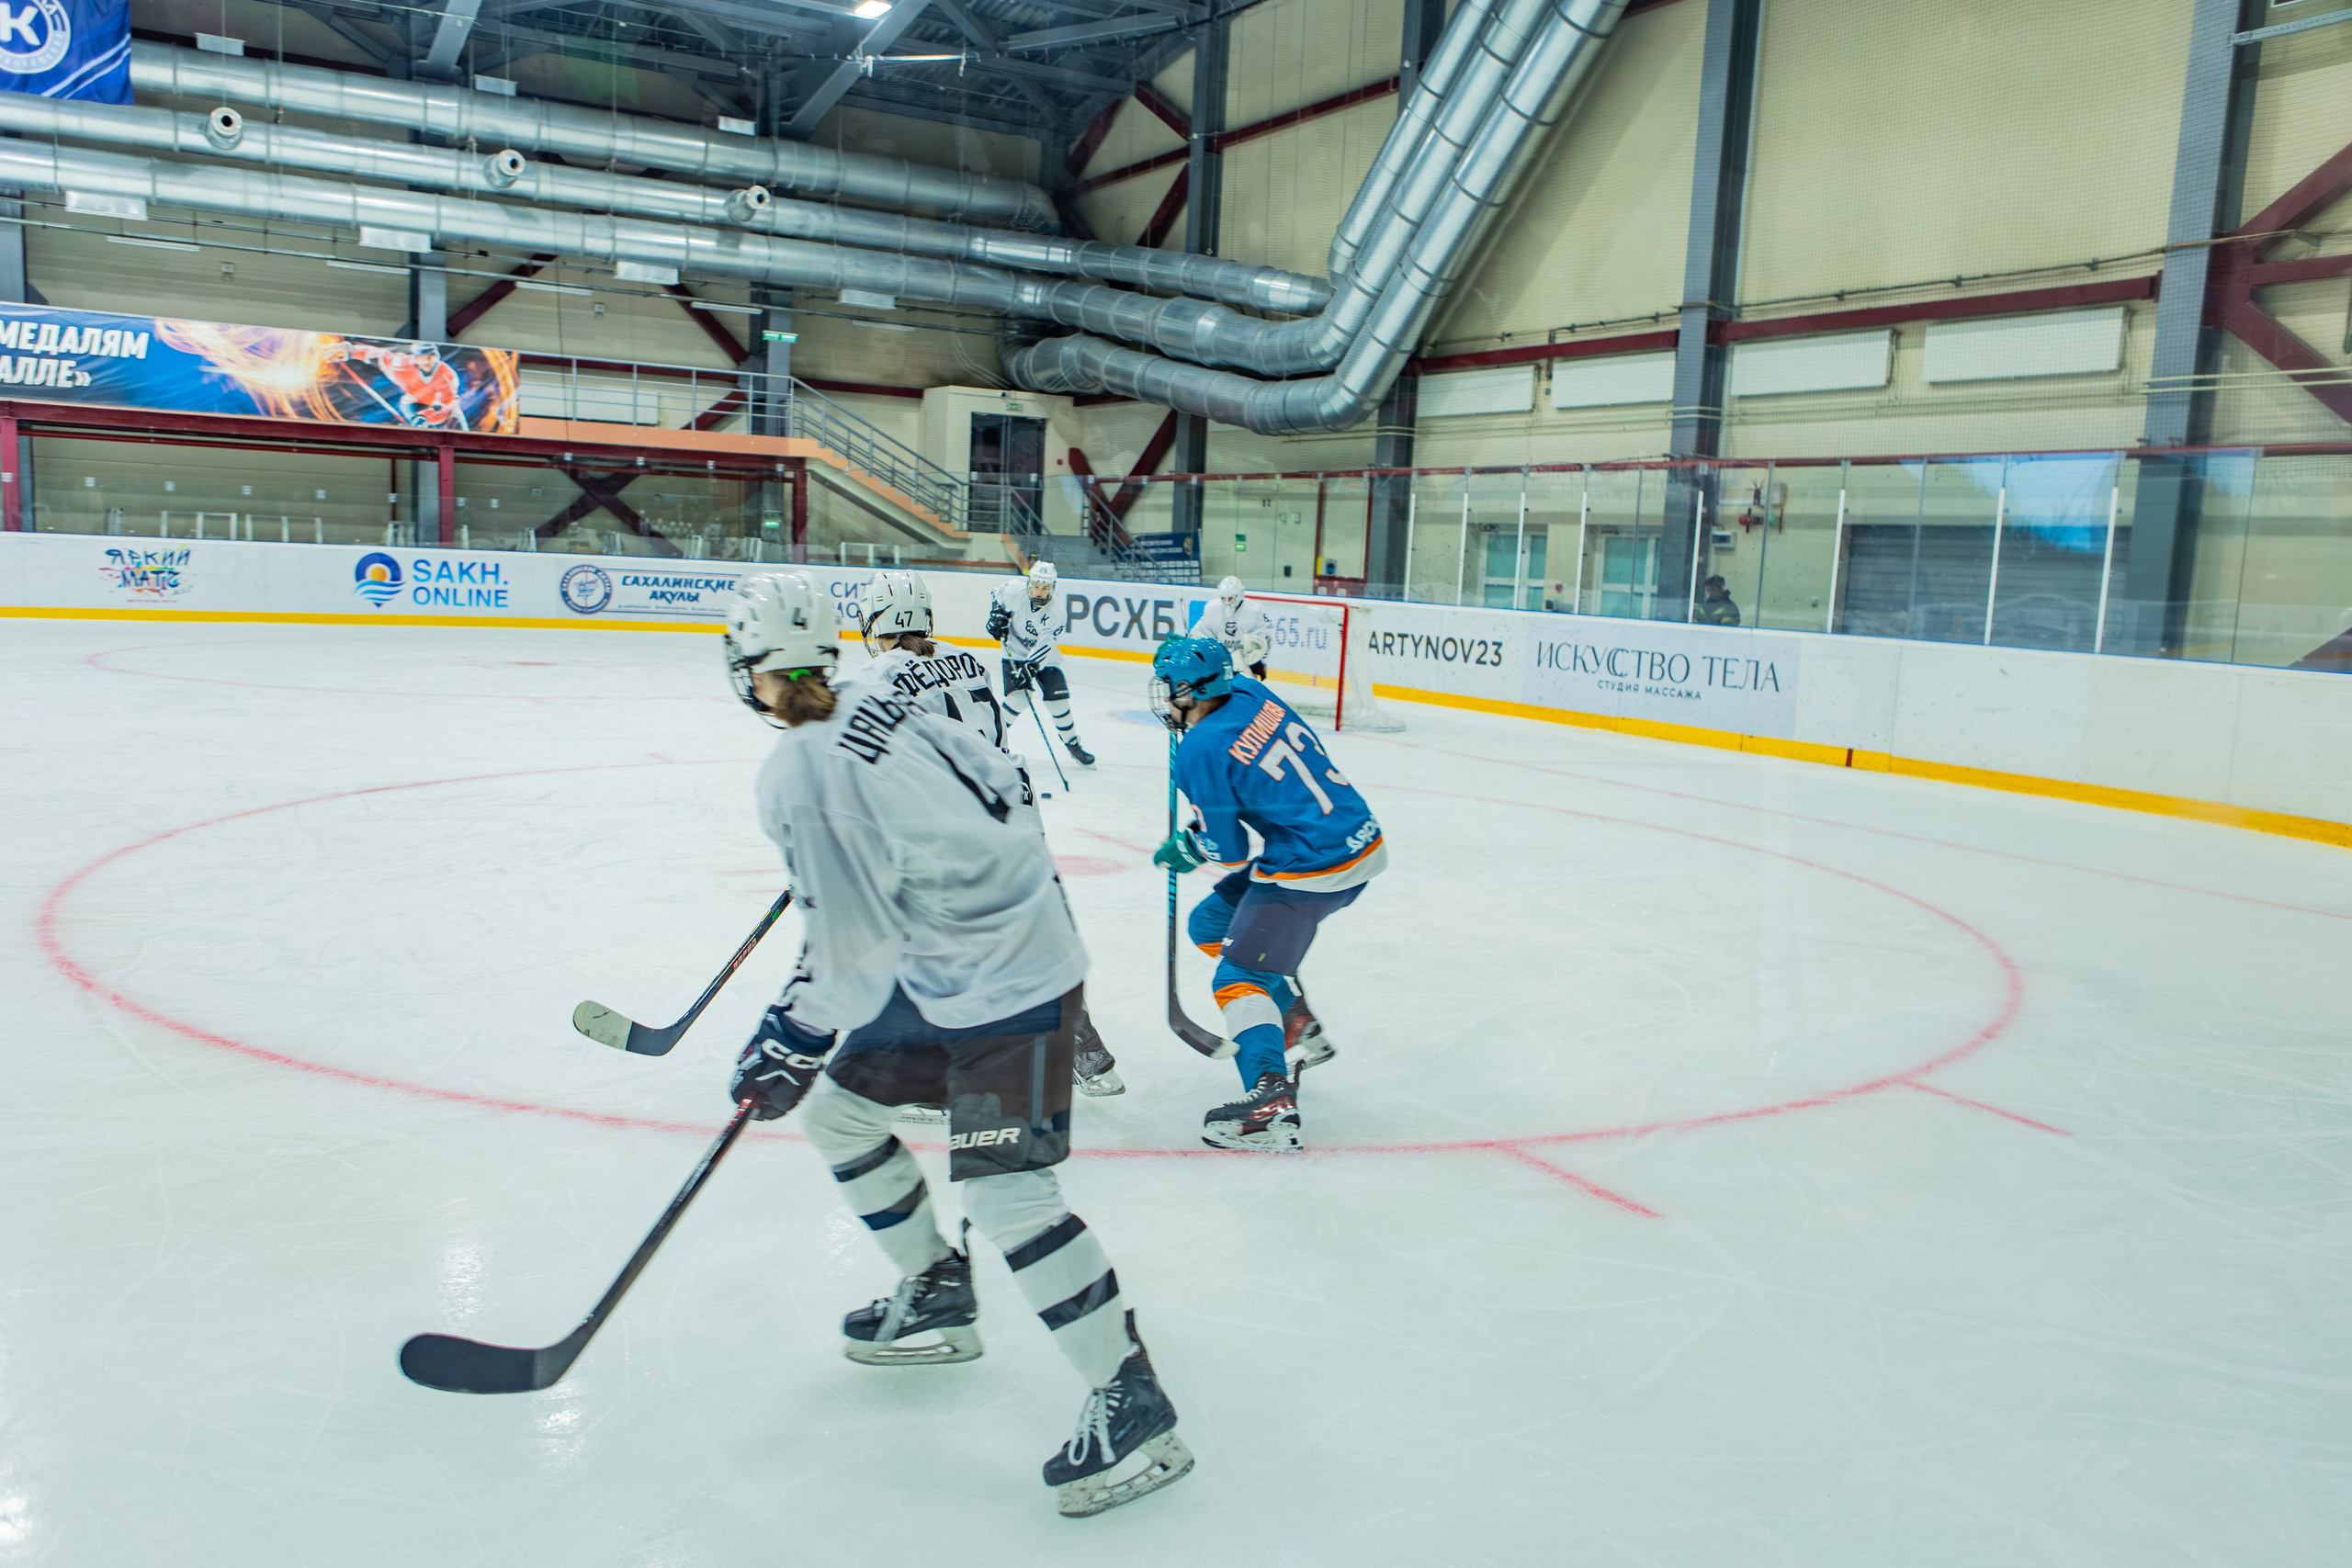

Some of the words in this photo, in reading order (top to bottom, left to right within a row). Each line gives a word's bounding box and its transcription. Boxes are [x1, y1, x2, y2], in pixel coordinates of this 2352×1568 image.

[0, 320, 150, 359] МЕДАЛЯМ
[413, 558, 508, 585] SAKH.
[621, 575, 736, 592] САХАЛИНСКИЕ
[413, 586, 508, 608] ONLINE
[649, 590, 700, 604] АКУЛЫ
[894, 610, 913, 628] 47
[1065, 593, 1175, 641] РСХБ
[1269, 616, 1328, 650] 65.ru
[1369, 630, 1503, 667] ARTYNOV23
[1537, 640, 1690, 683] ИСКУССТВО
[1702, 656, 1781, 693] ТЕЛА
[1597, 680, 1639, 694] СТУДИЯ
[1645, 685, 1702, 700] МАССАЖА
[1258, 721, 1349, 816] 73
